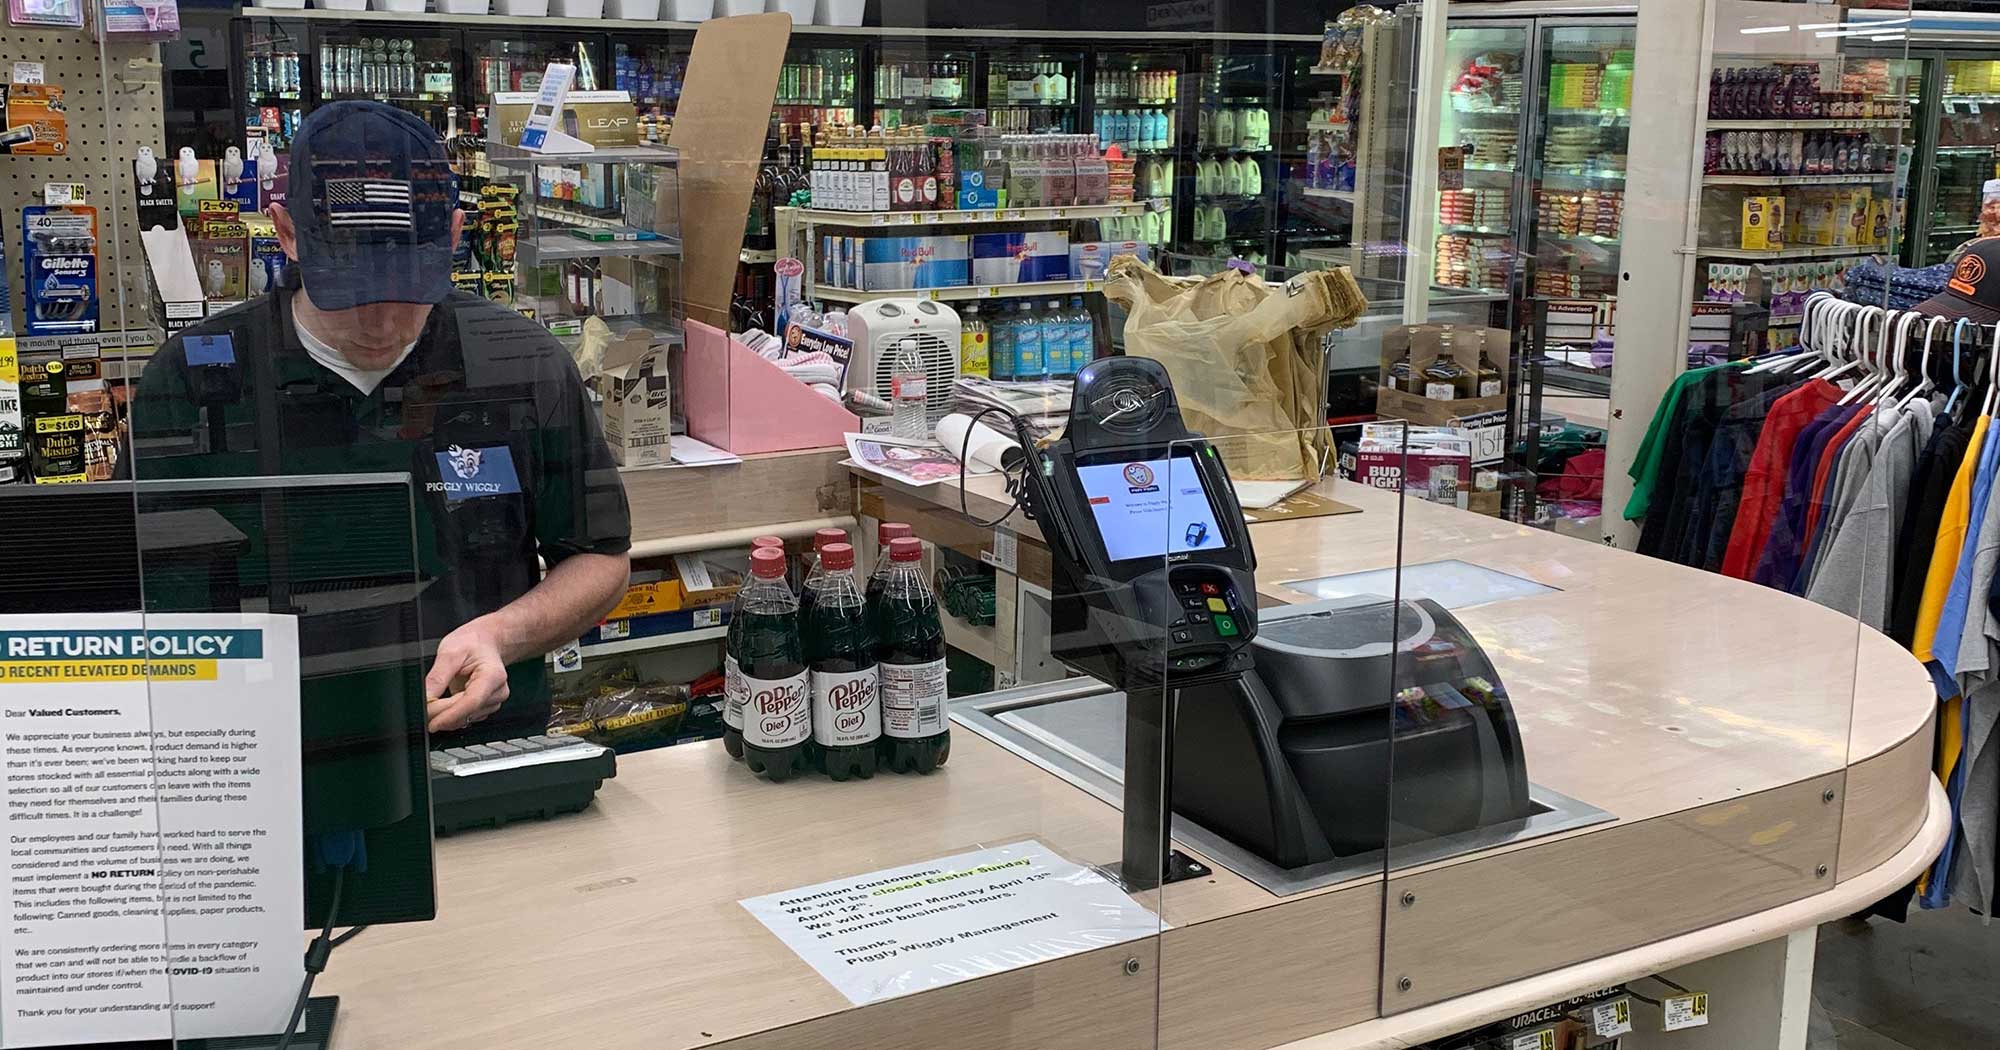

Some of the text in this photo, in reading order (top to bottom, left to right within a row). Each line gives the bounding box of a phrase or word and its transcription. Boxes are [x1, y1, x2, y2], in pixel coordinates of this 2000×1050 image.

[587, 117, 629, 129] LEAP
[70, 184, 85, 200] 1.69
[203, 202, 210, 211] 2
[37, 217, 51, 227] 40
[902, 247, 935, 256] Red Bull
[1023, 242, 1037, 251] Bull
[41, 257, 89, 269] Gillette
[168, 320, 184, 328] BLACK
[17, 339, 28, 347] he
[30, 338, 56, 347] mouth
[58, 337, 73, 346] and
[129, 335, 145, 344] you
[800, 333, 849, 360] Everyday Low Price!
[21, 364, 45, 373] Dutch
[650, 390, 667, 400] BIC
[38, 422, 47, 431] 3
[55, 420, 80, 430] $1.69
[1461, 420, 1482, 430] Everyday
[1482, 417, 1492, 425] Low
[47, 437, 76, 448] Dutch
[40, 445, 80, 458] Masters
[1369, 466, 1401, 477] BUD
[426, 482, 501, 493] PIGGLY WIGGLY
[1362, 477, 1402, 488] LIGHT
[8, 636, 122, 657] RETURN
[131, 636, 233, 655] POLICY
[9, 666, 60, 678] RECENT
[64, 665, 128, 676] ELEVATED
[131, 664, 196, 675] DEMANDS
[773, 685, 793, 701] Dr
[849, 679, 866, 698] Dr
[759, 686, 803, 715] Pepper
[834, 681, 875, 711] Pepper
[766, 720, 784, 732] Diet
[841, 716, 859, 729] Diet
[23, 733, 70, 741] appreciate
[184, 729, 227, 737] especially
[228, 729, 256, 737] during
[185, 742, 220, 750] demand
[231, 742, 258, 750] higher
[107, 770, 145, 778] essential
[68, 797, 117, 805] themselves
[11, 861, 61, 869] considered
[109, 869, 155, 877] RETURN
[197, 867, 260, 876] non-perishable
[779, 869, 941, 906] Attention Customers:
[786, 858, 1031, 914] We will be closed Easter Sunday
[804, 922, 832, 931] We
[836, 913, 864, 924] will
[868, 901, 922, 917] reopen
[925, 888, 985, 904] Monday
[989, 879, 1024, 891] April
[798, 910, 835, 923] April
[816, 891, 1017, 940] at normal business hours.
[846, 911, 1059, 966] Piggly Wiggly Management
[47, 946, 100, 955] consistently
[834, 939, 897, 956] Thanks
[16, 985, 65, 994] maintained
[100, 1003, 161, 1013] understanding
